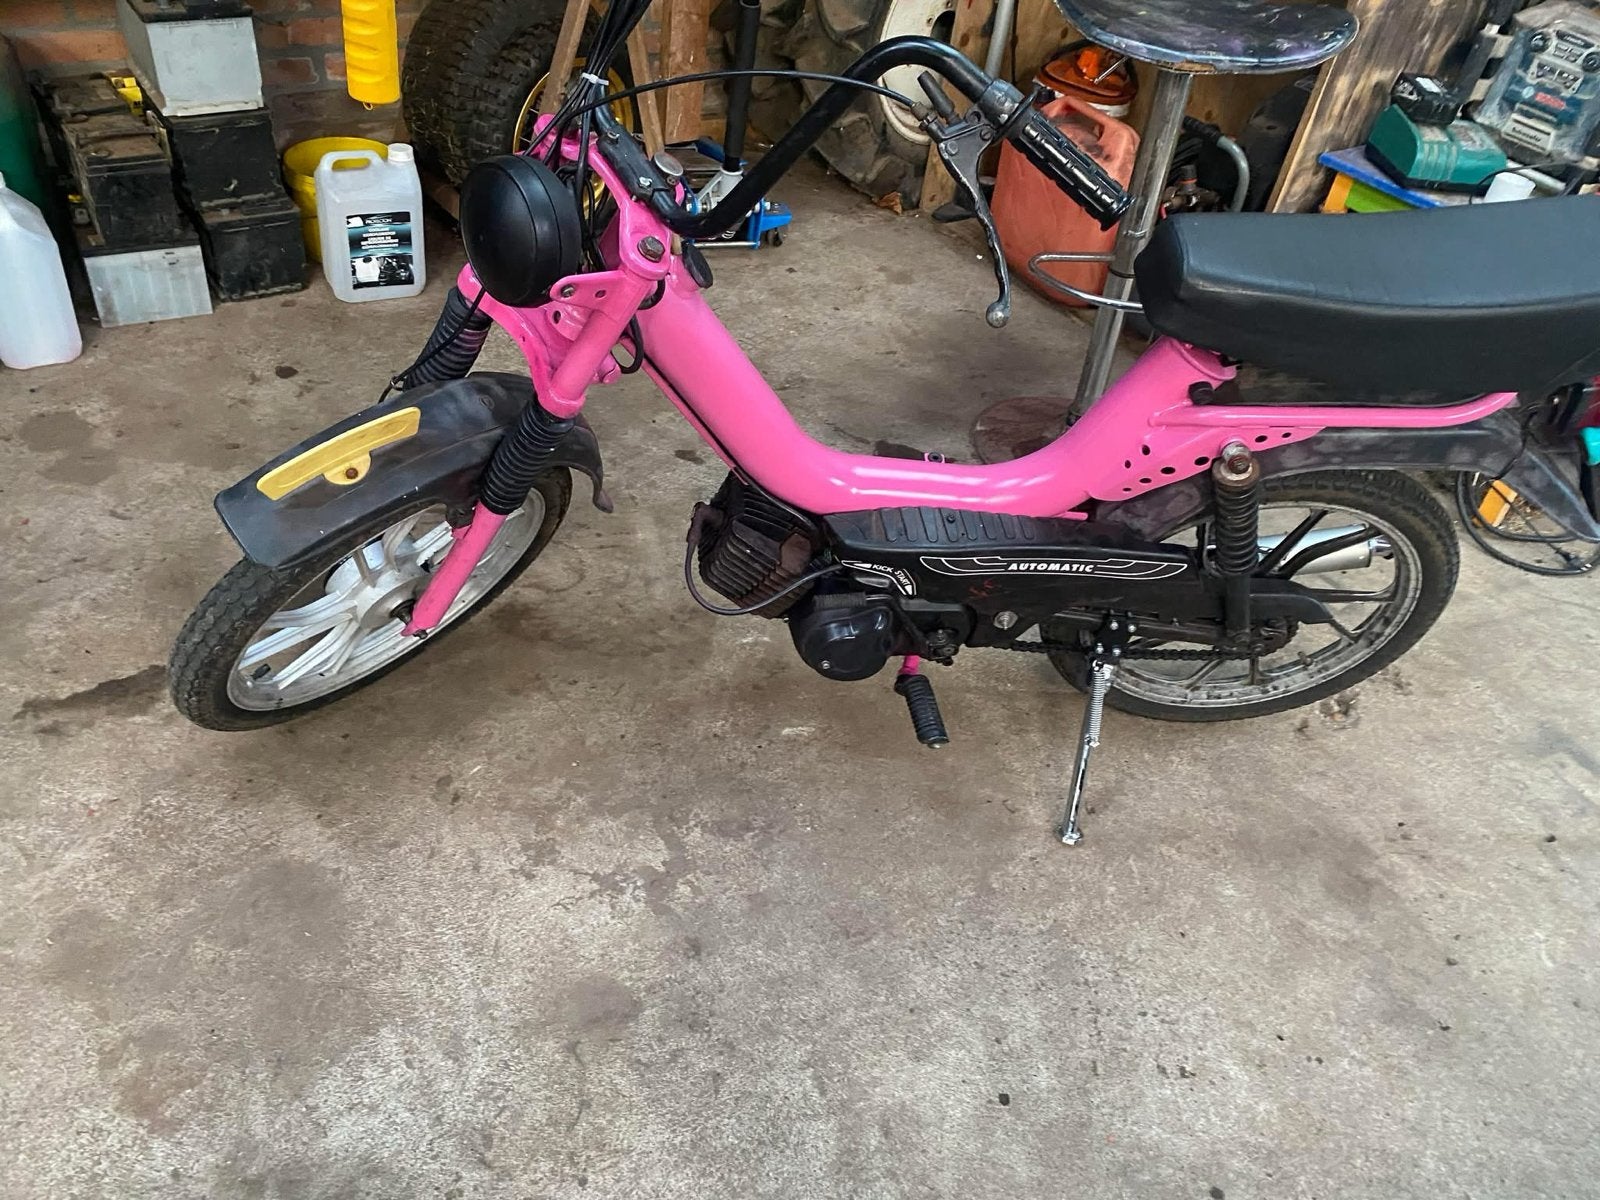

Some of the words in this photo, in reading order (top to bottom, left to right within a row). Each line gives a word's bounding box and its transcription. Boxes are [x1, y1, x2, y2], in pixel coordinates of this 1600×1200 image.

[872, 564, 894, 573] KICK
[894, 570, 911, 585] START
[1007, 562, 1094, 572] AUTOMATIC
